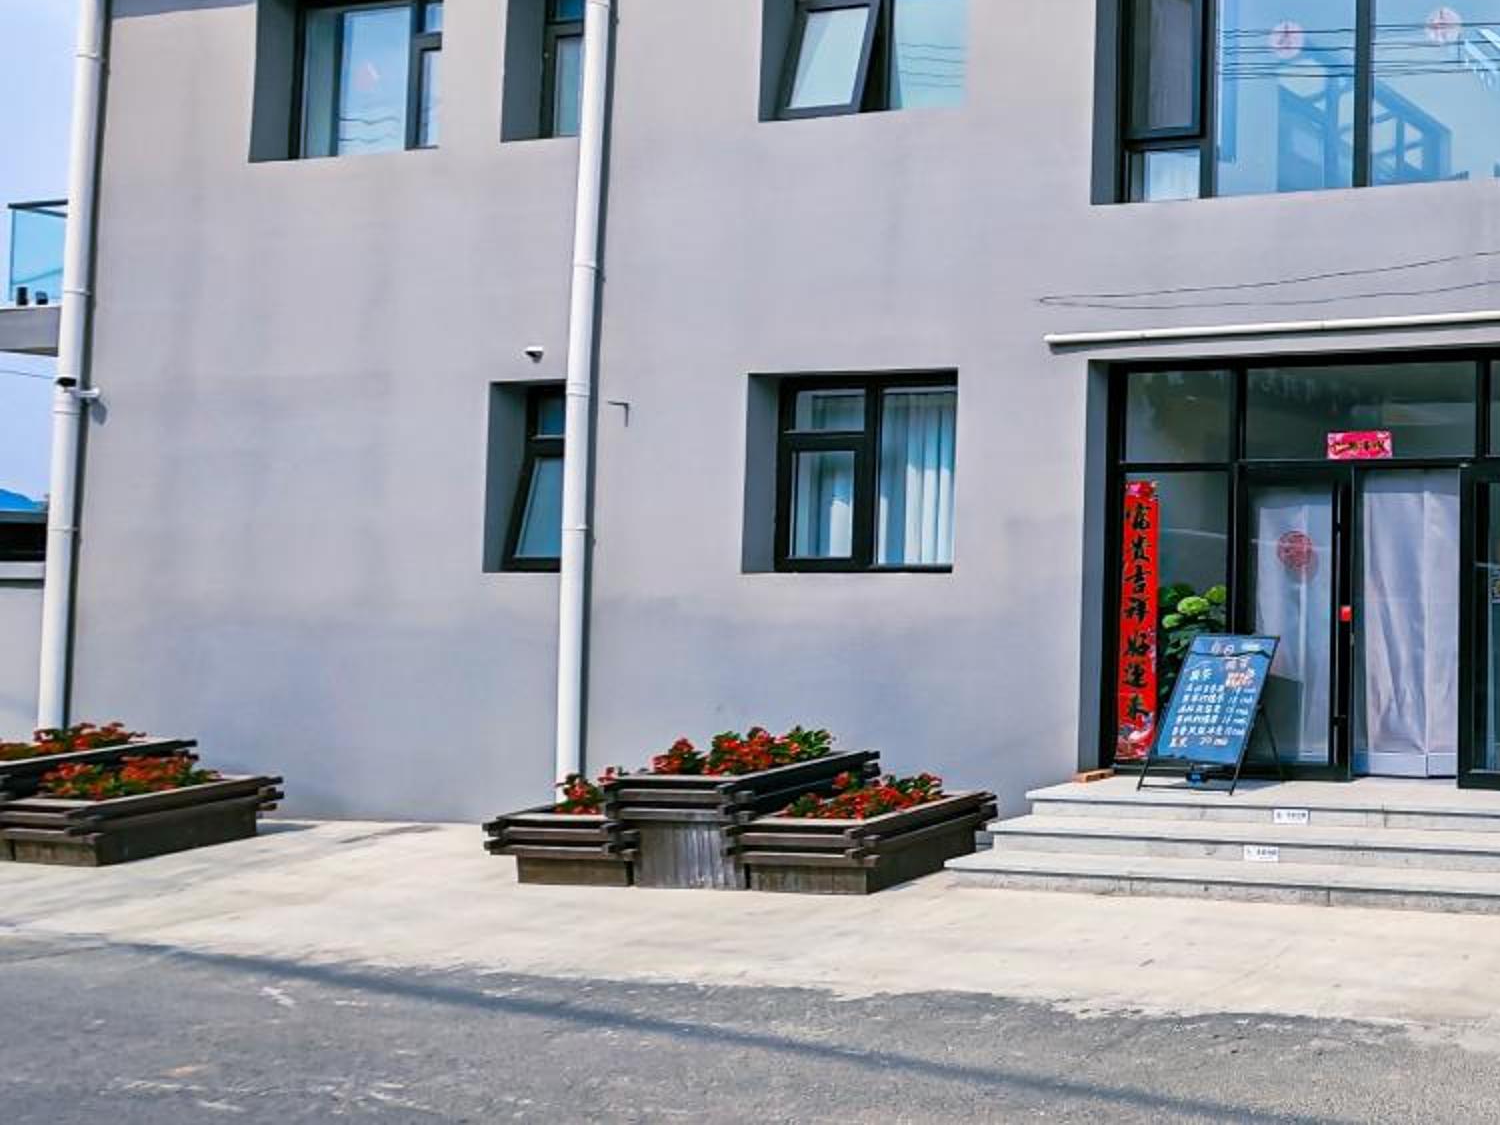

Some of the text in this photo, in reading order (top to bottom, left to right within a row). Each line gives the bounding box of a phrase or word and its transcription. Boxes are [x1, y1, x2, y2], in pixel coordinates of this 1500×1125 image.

[1123, 503, 1152, 717] 富贵吉祥好运来
